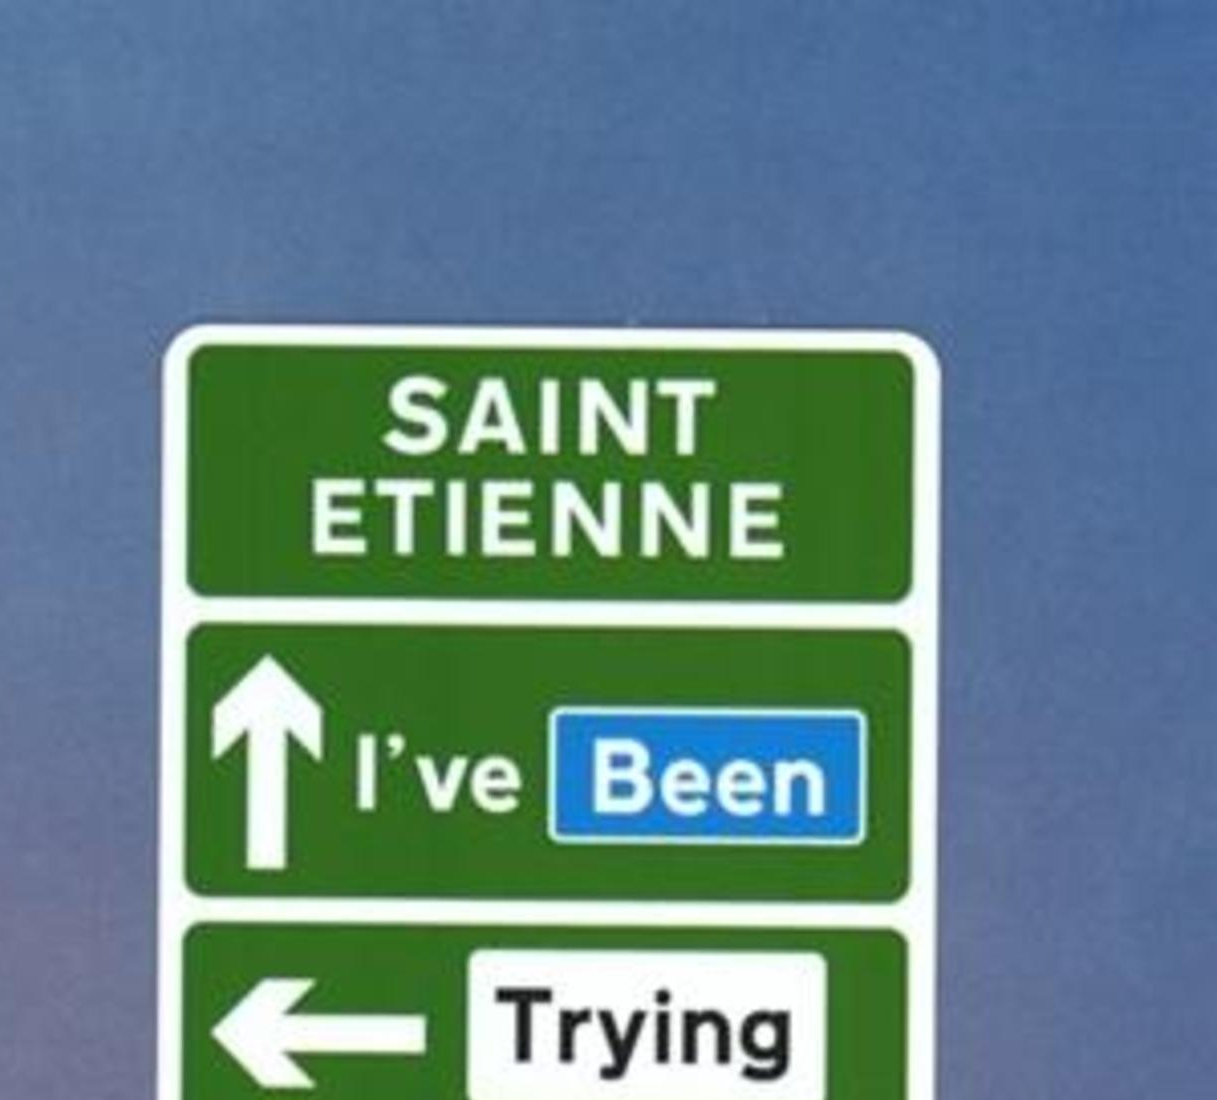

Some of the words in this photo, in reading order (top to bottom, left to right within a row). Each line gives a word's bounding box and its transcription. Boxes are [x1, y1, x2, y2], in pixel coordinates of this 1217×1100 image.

[382, 374, 716, 457] SAINT
[313, 477, 784, 559] ETIENNE
[356, 733, 521, 813] I've
[593, 738, 827, 817] Been
[495, 987, 791, 1080] Trying
